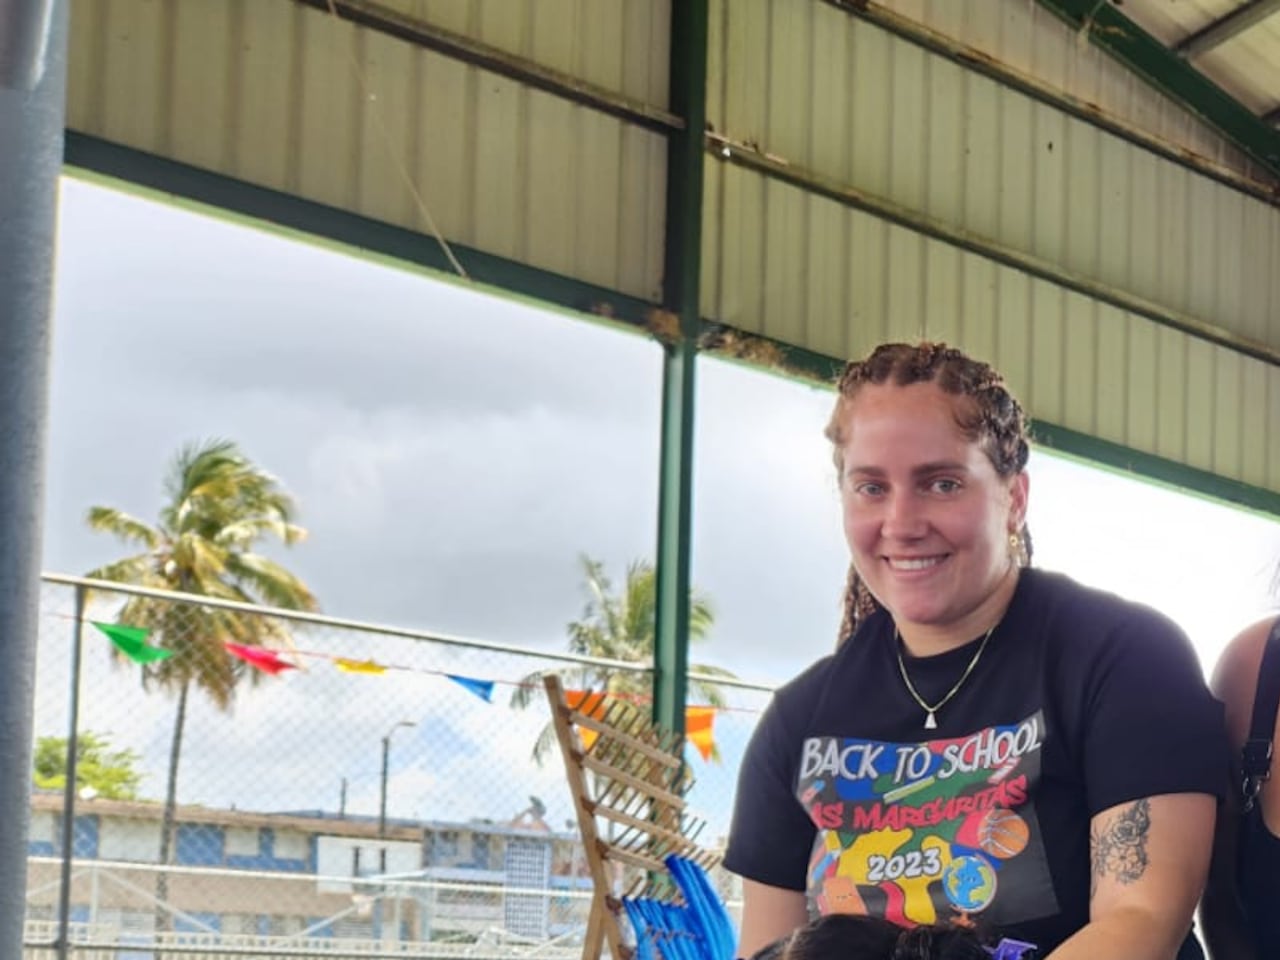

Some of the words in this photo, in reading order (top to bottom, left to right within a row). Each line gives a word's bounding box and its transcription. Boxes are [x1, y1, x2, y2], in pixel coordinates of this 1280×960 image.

[800, 737, 884, 780] BACK
[895, 746, 931, 784] TO
[938, 717, 1042, 779] SCHOOL
[867, 849, 940, 882] 2023
